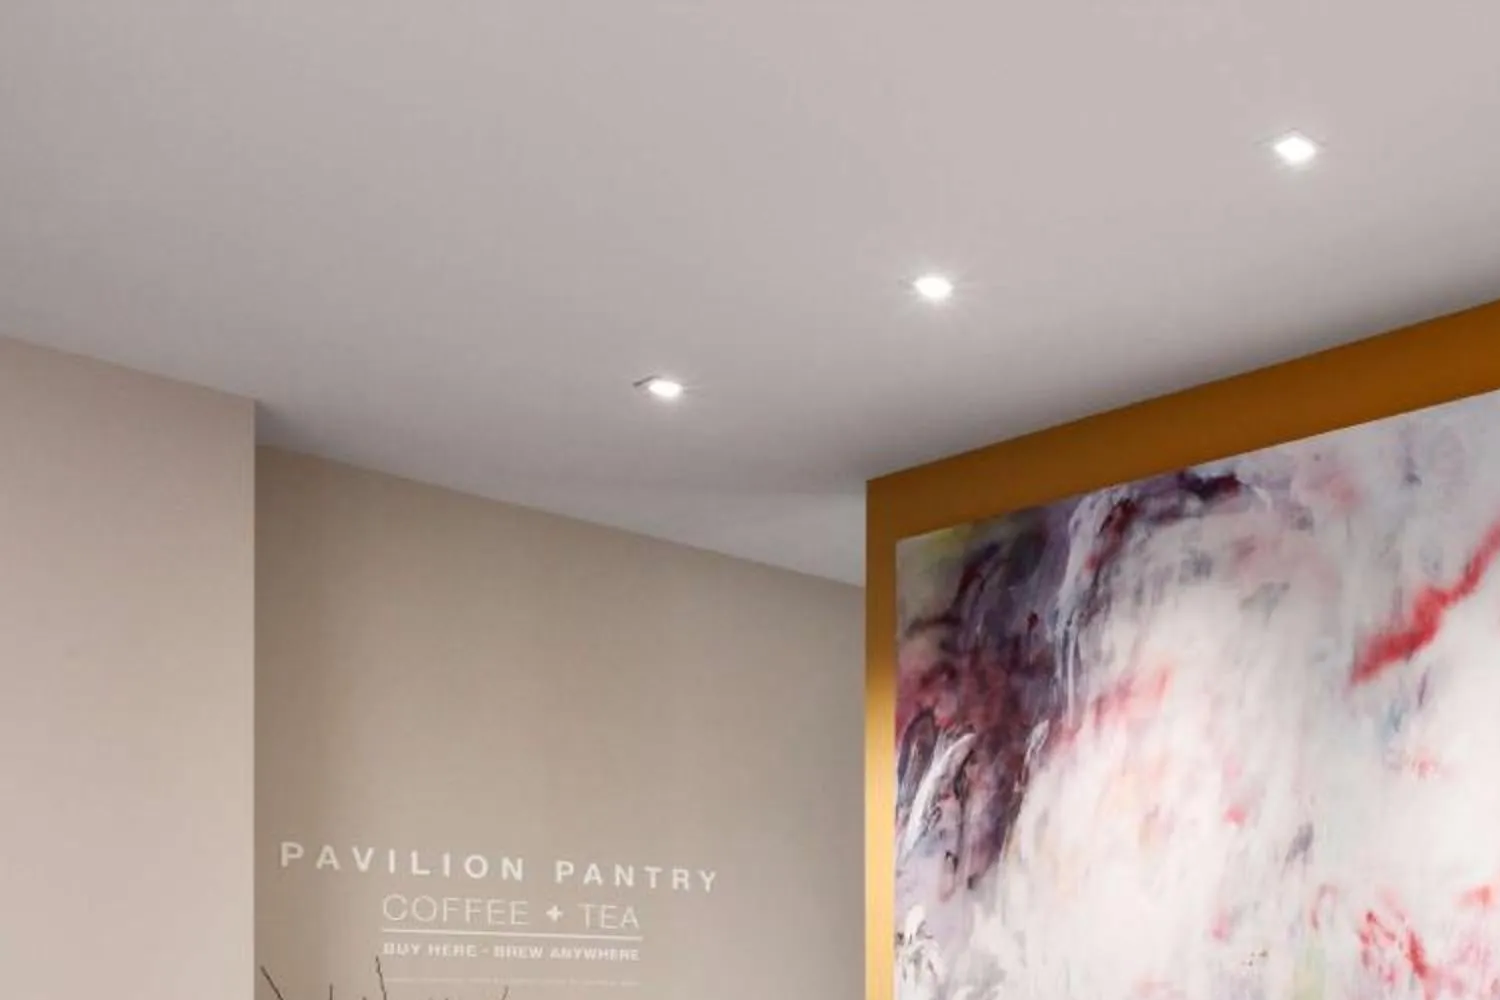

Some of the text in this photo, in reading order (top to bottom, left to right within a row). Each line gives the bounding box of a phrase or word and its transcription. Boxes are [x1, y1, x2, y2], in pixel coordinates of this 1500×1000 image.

[280, 841, 717, 892] PAVILION PANTRY
[382, 894, 529, 925] COFFEE
[578, 904, 640, 930] TEA
[383, 943, 421, 956] BUY
[429, 944, 477, 957] HERE
[494, 946, 543, 959] BREW
[549, 948, 640, 962] ANYWHERE
